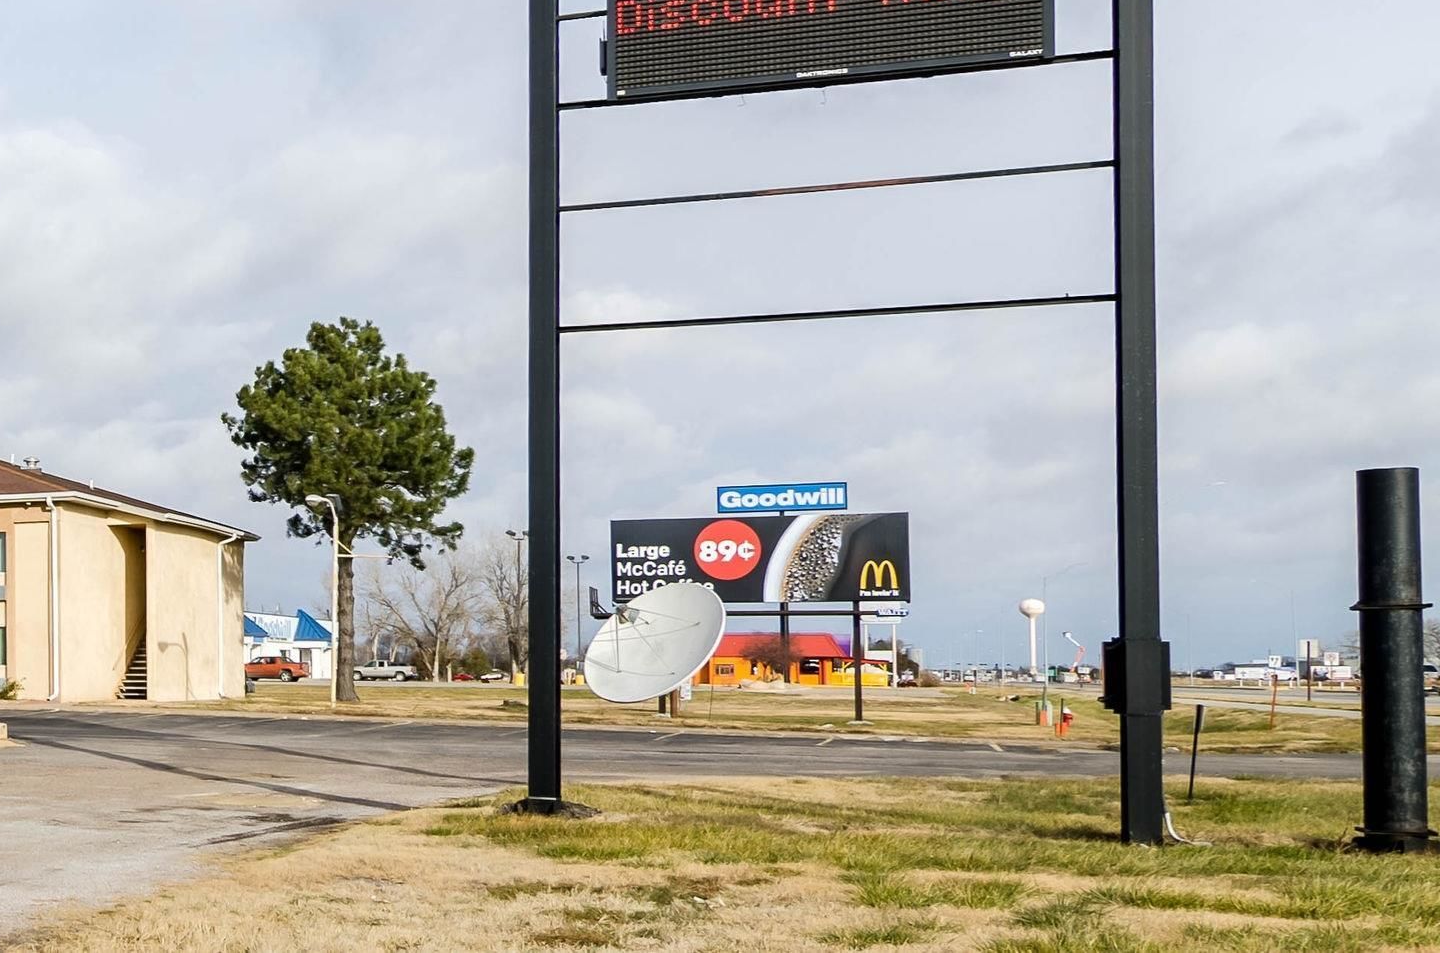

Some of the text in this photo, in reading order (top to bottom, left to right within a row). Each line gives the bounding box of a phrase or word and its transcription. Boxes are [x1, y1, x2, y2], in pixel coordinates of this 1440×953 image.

[719, 487, 844, 509] Goodwill
[616, 543, 671, 560] Large
[698, 539, 756, 563] 89¢
[616, 559, 687, 577] McCafé
[616, 579, 650, 595] Hot
